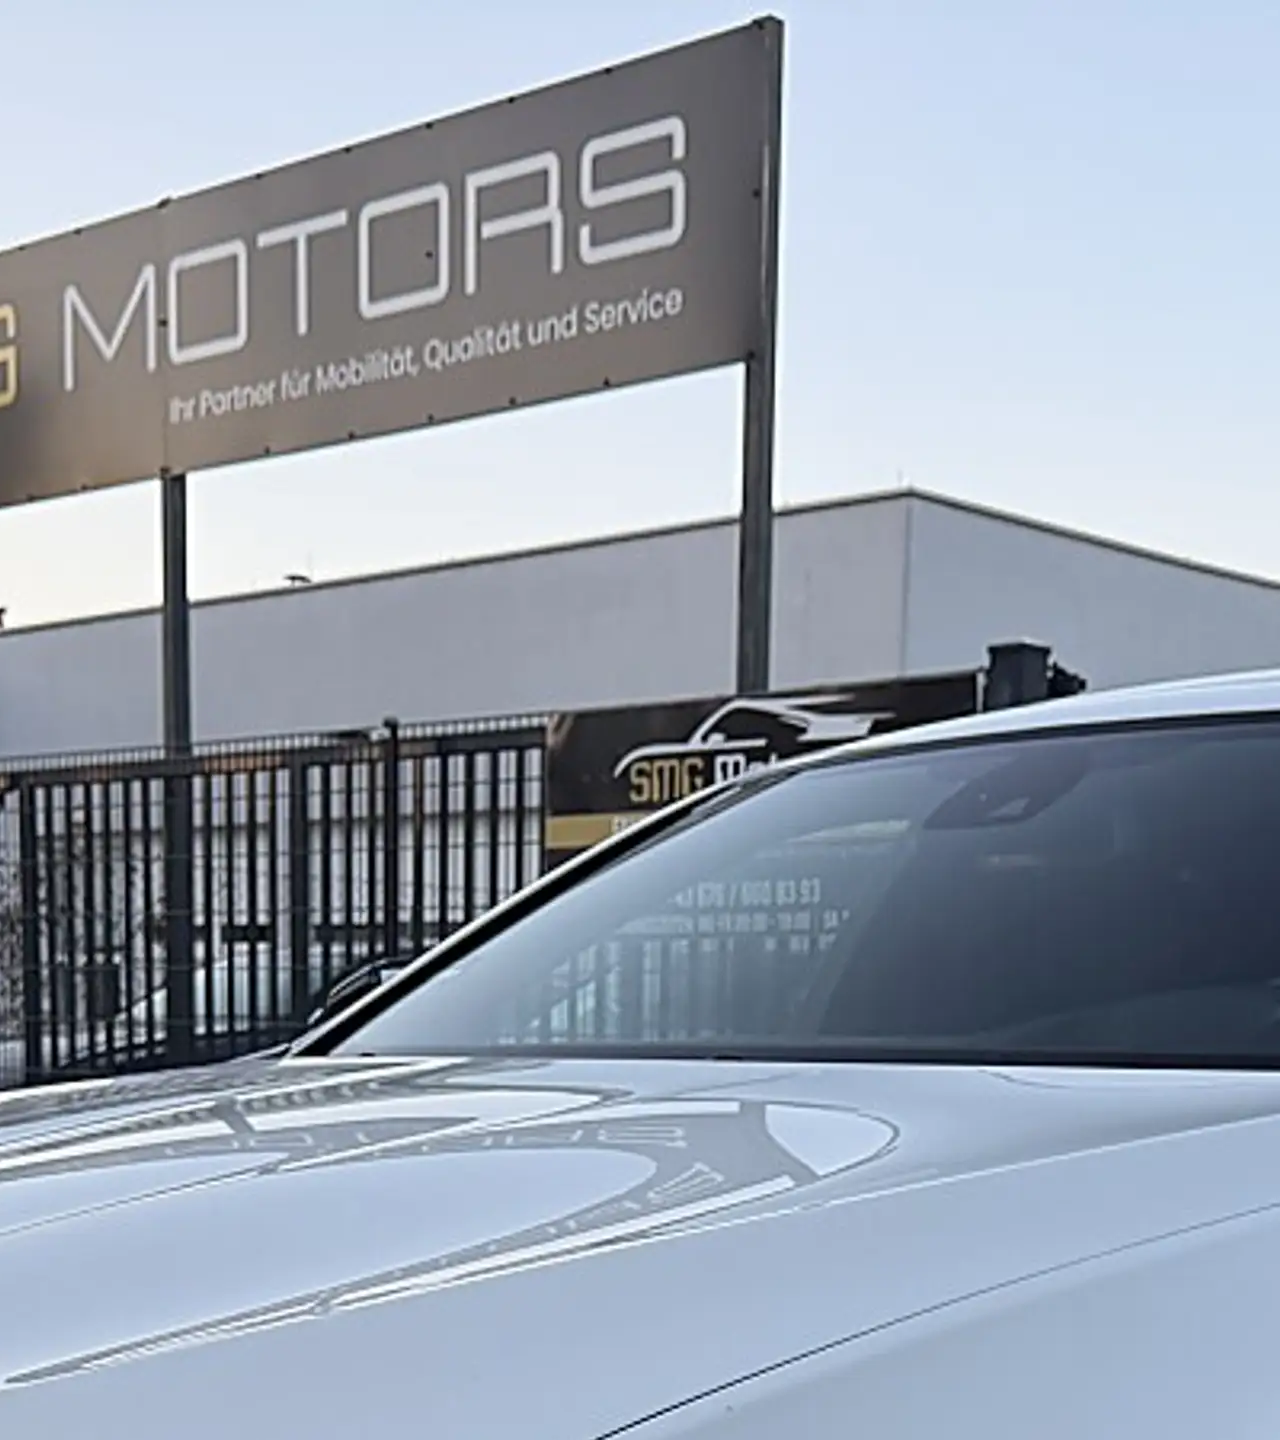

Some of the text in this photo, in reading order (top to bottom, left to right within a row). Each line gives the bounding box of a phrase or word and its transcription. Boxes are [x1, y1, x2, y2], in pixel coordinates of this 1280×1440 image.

[61, 114, 687, 392] MOTORS
[170, 286, 684, 425] Ihr Partner für Mobilität, Qualität und Service
[629, 755, 705, 804] SMG
